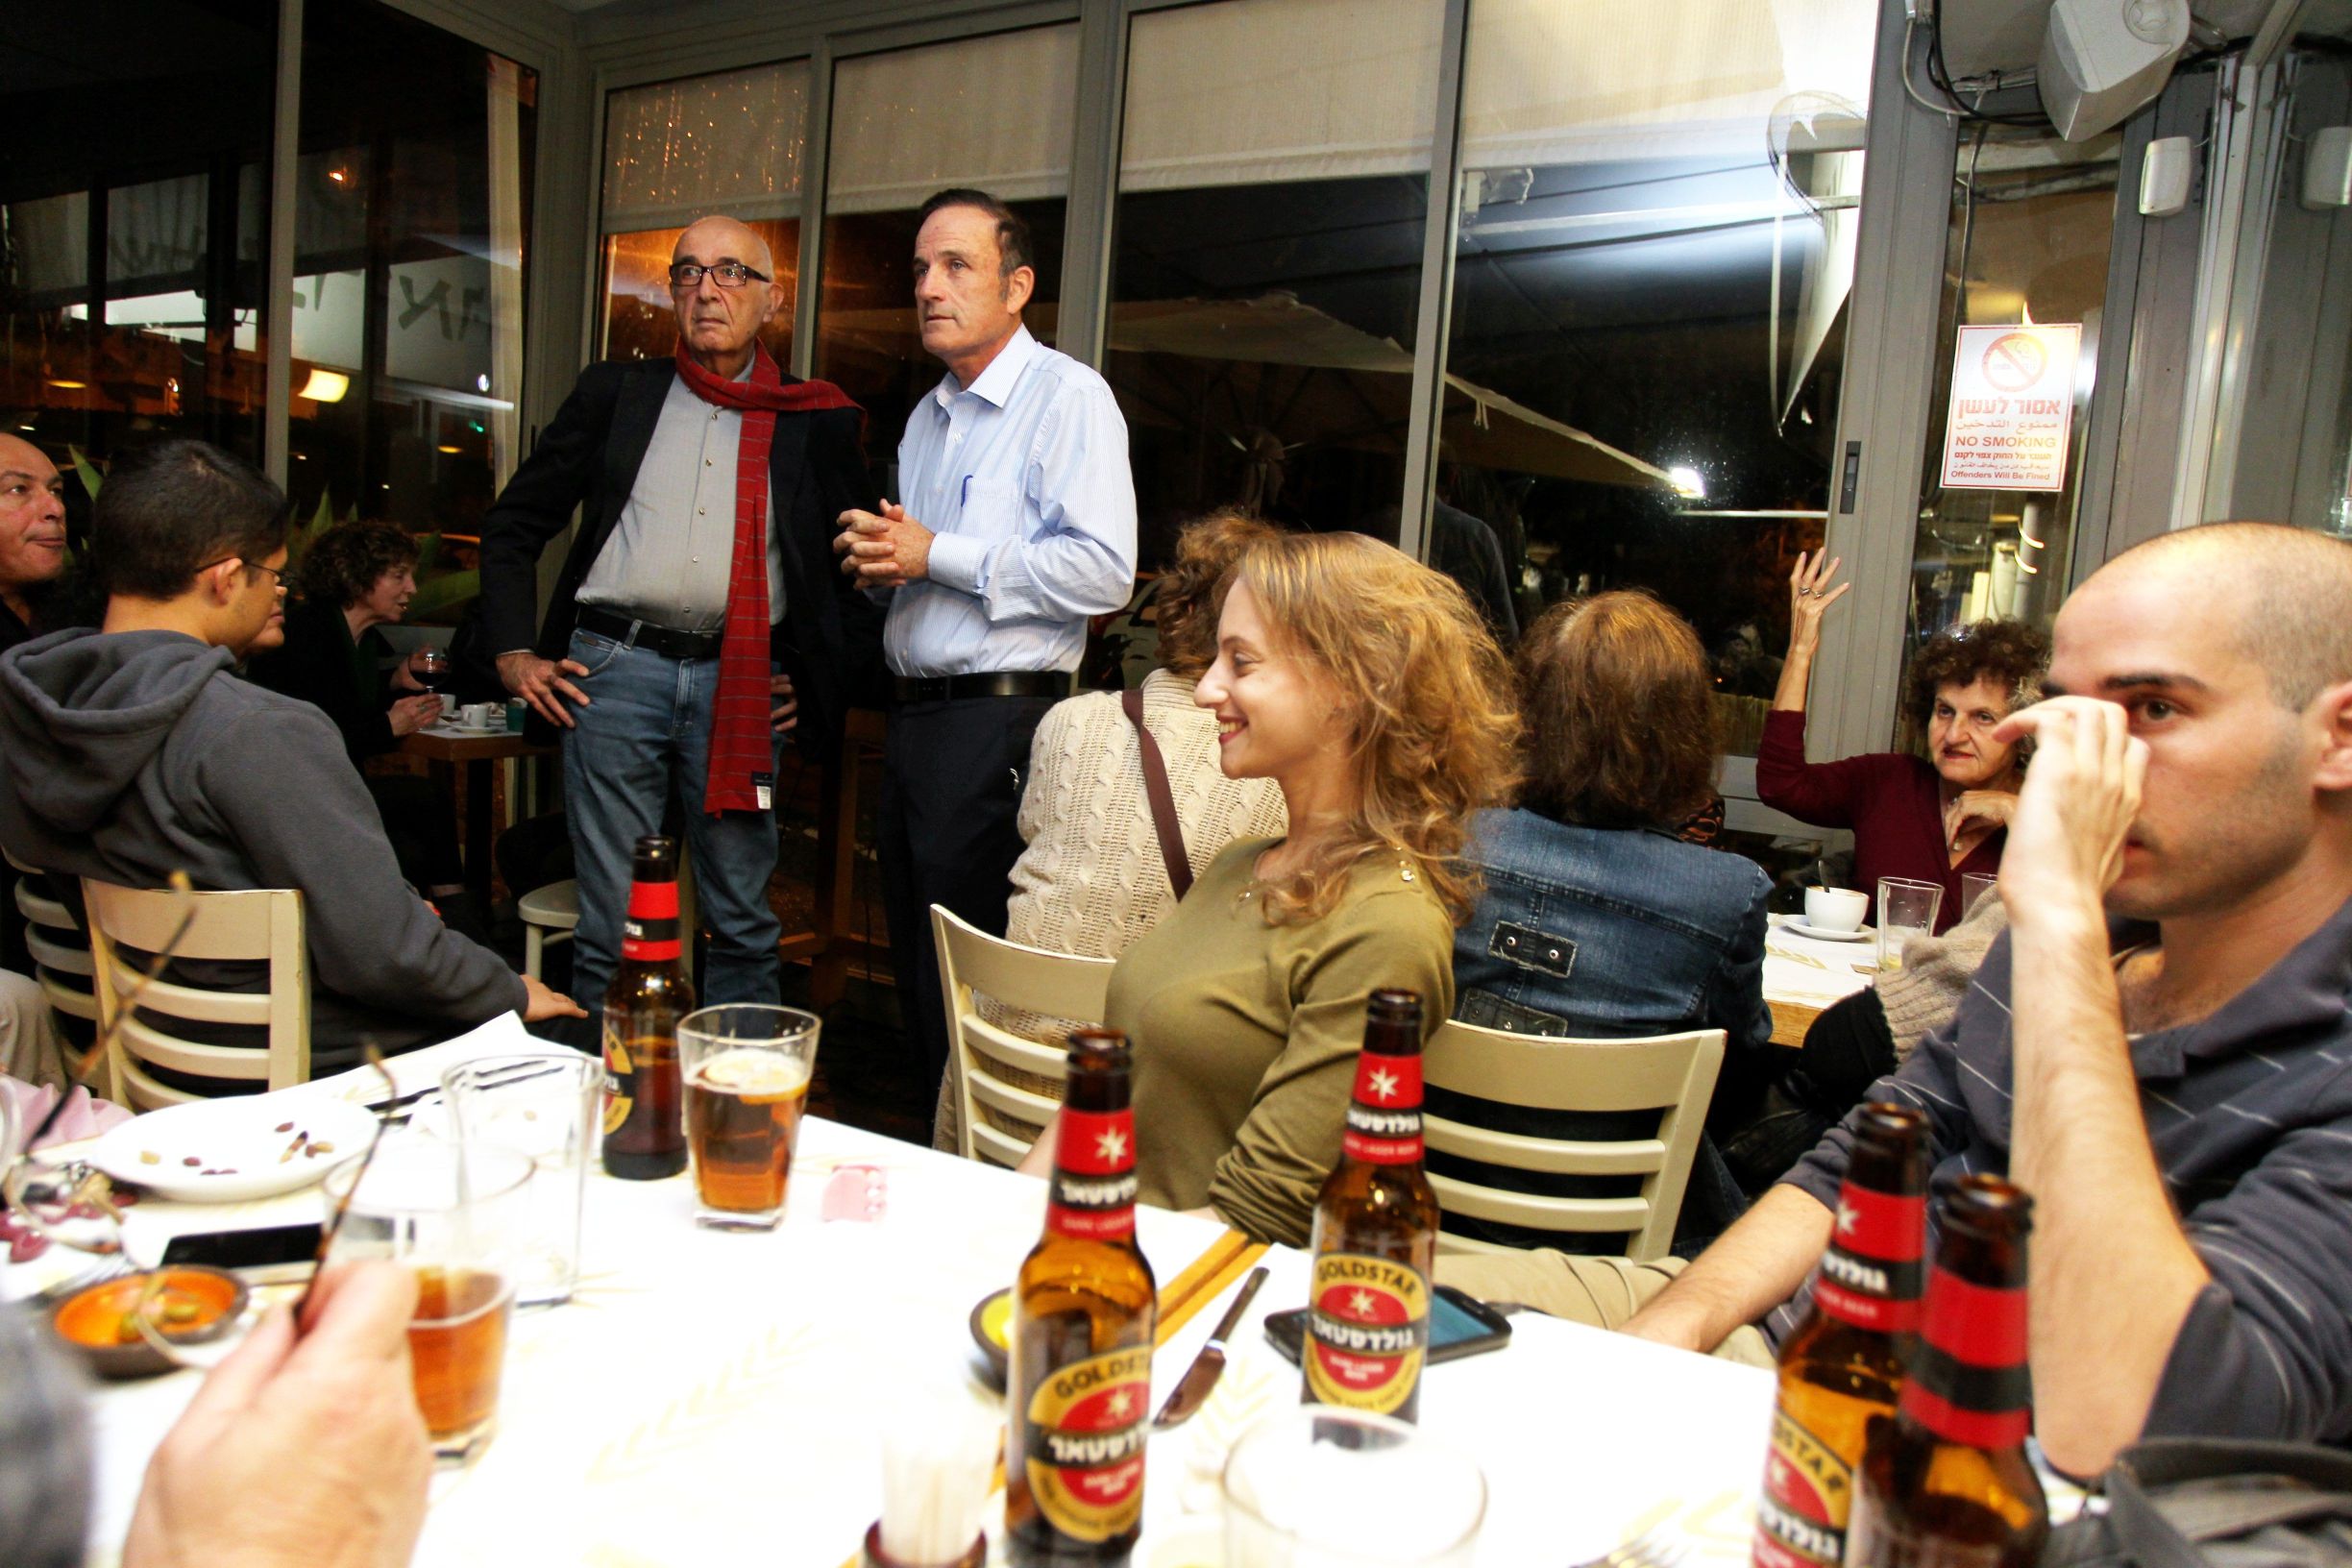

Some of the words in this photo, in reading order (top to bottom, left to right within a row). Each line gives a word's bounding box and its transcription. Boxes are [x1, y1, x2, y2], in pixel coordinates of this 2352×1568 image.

[1958, 397, 2009, 419] לעשן
[2015, 399, 2061, 415] אסור
[1955, 435, 1978, 447] NO
[1982, 436, 2057, 448] SMOKING
[1950, 470, 1992, 478] Offenders
